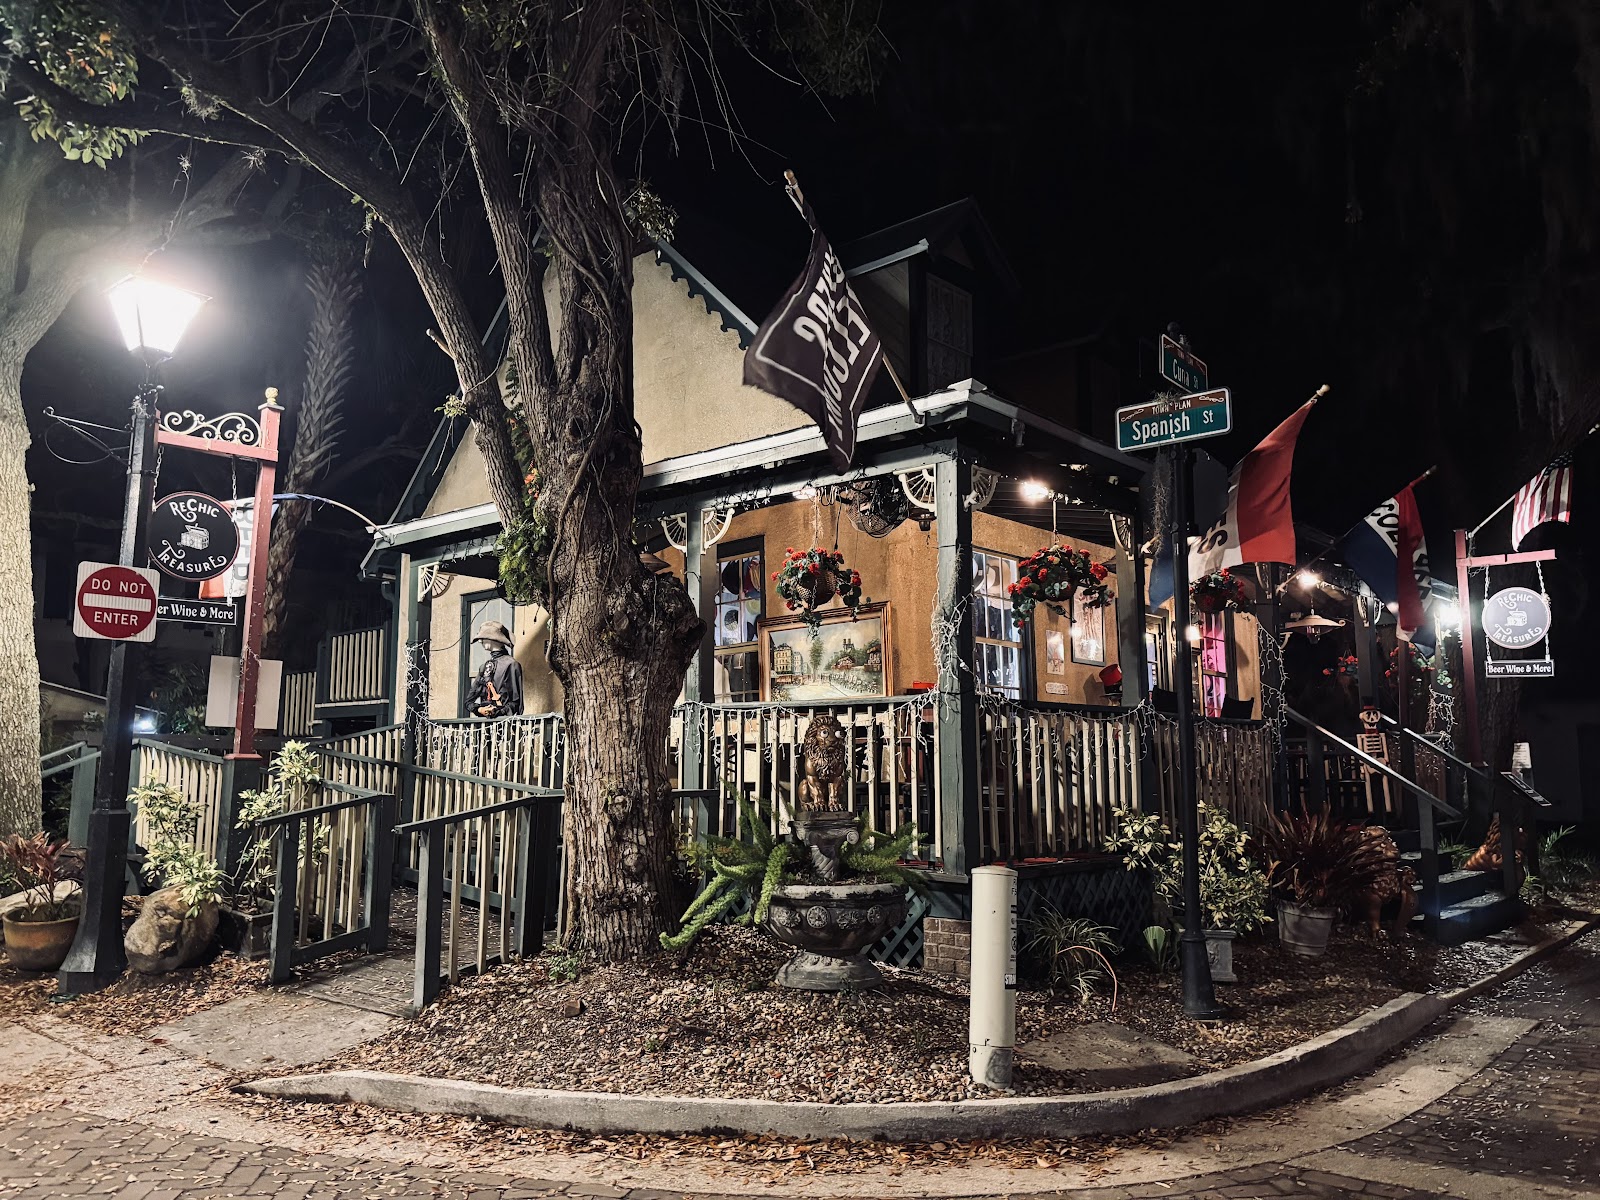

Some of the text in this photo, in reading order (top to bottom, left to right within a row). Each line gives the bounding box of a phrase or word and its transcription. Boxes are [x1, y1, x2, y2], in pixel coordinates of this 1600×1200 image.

[1152, 400, 1191, 415] TOWN PLAN
[1132, 410, 1214, 443] Spanish St
[91, 577, 148, 595] DO NOT
[94, 612, 138, 626] ENTER
[157, 604, 234, 620] er Wine & More
[1488, 664, 1552, 674] Beer Wine & More
